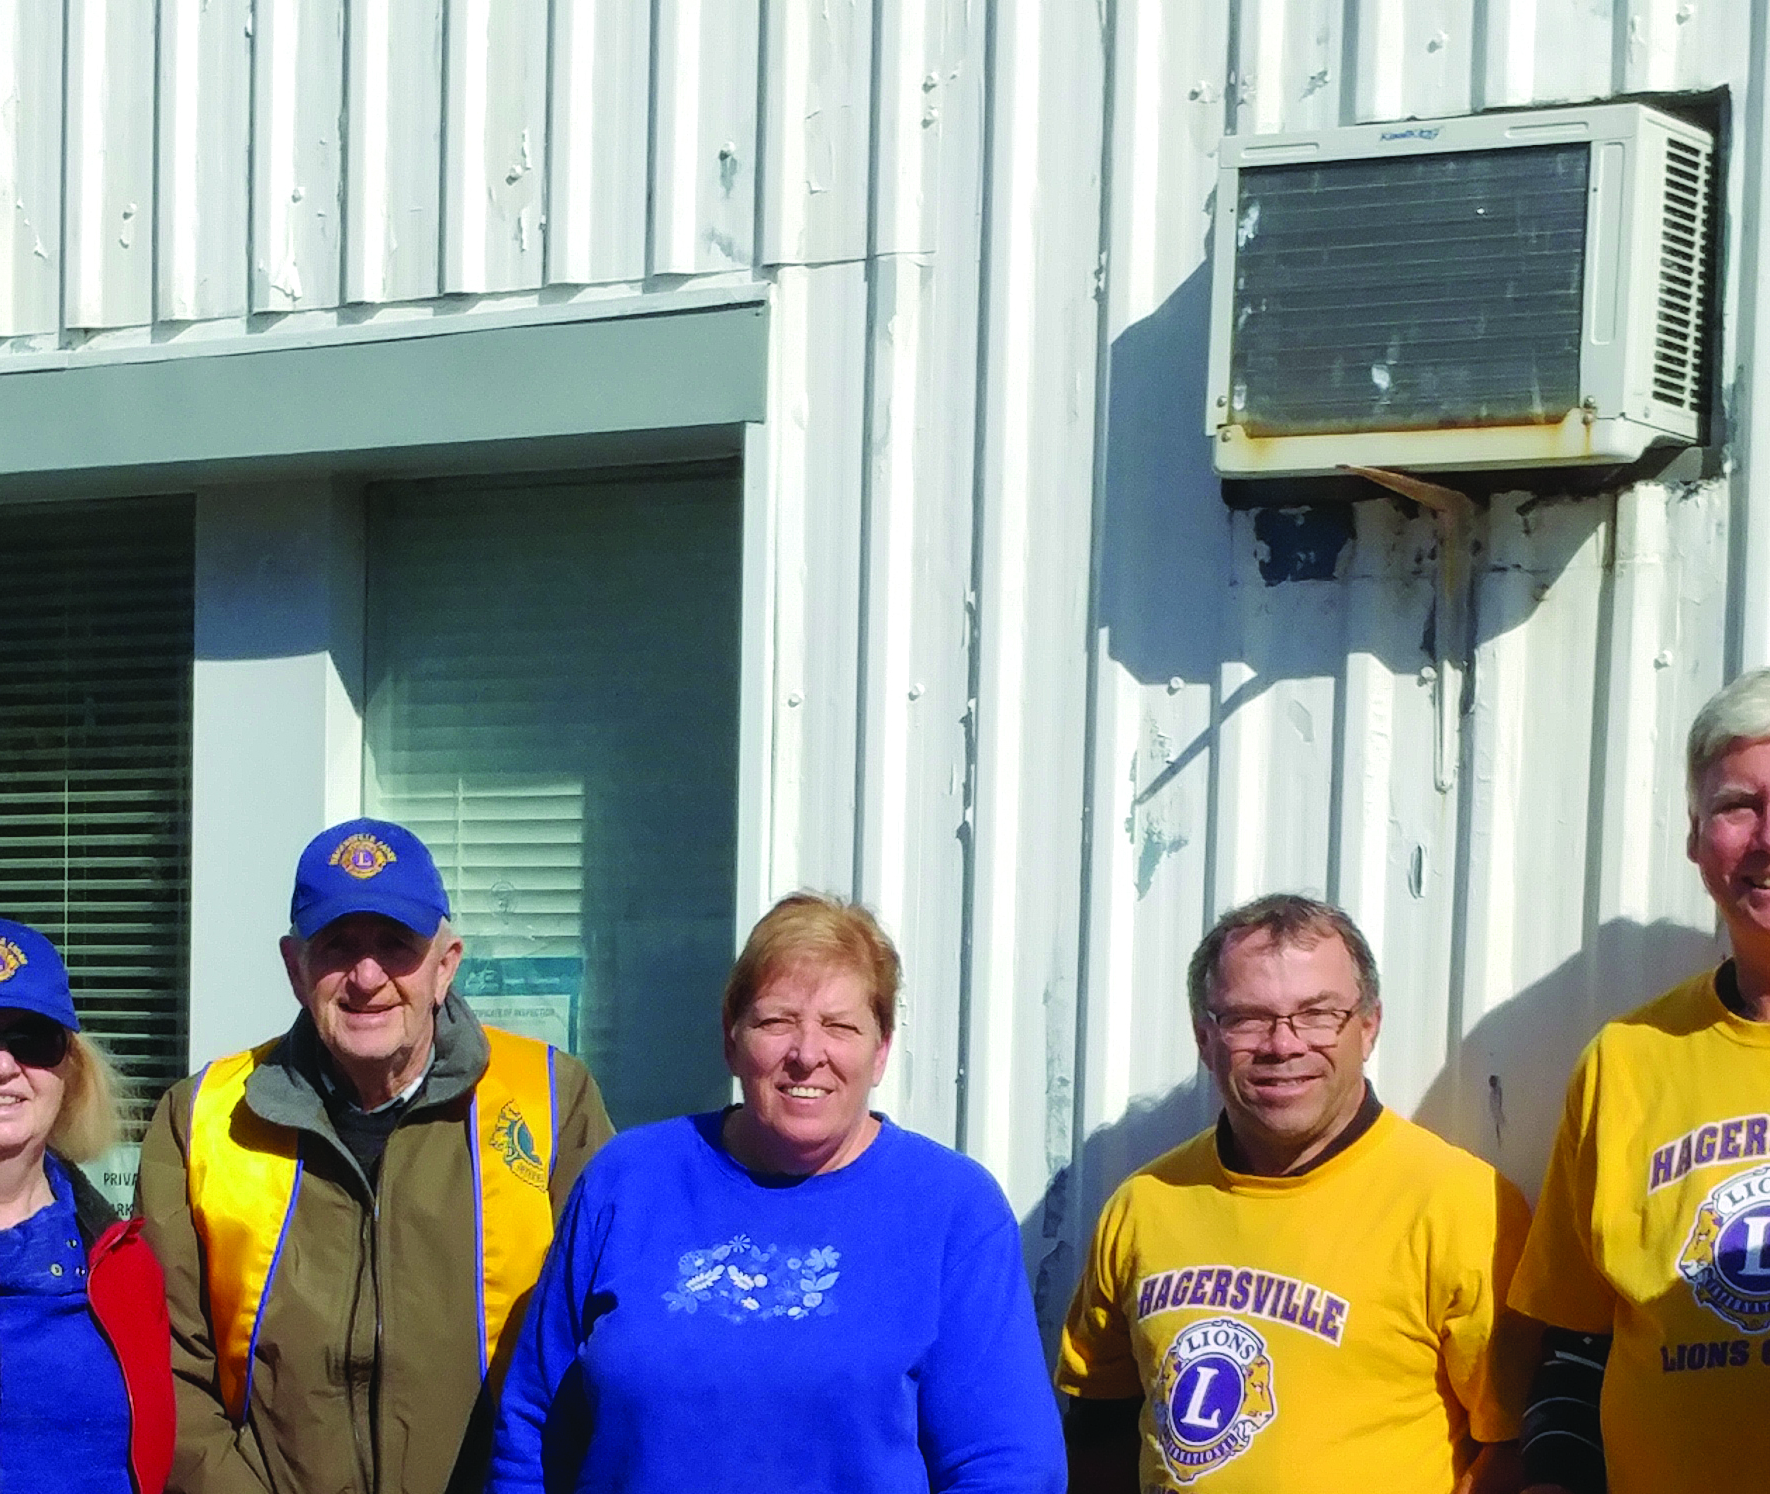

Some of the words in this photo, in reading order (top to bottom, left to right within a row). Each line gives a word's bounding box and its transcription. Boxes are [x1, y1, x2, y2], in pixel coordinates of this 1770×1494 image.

[1138, 1266, 1349, 1346] HAGERSVILLE
[1187, 1327, 1255, 1360] LIONS
[1660, 1340, 1750, 1371] LIONS
[1180, 1366, 1222, 1429] L
